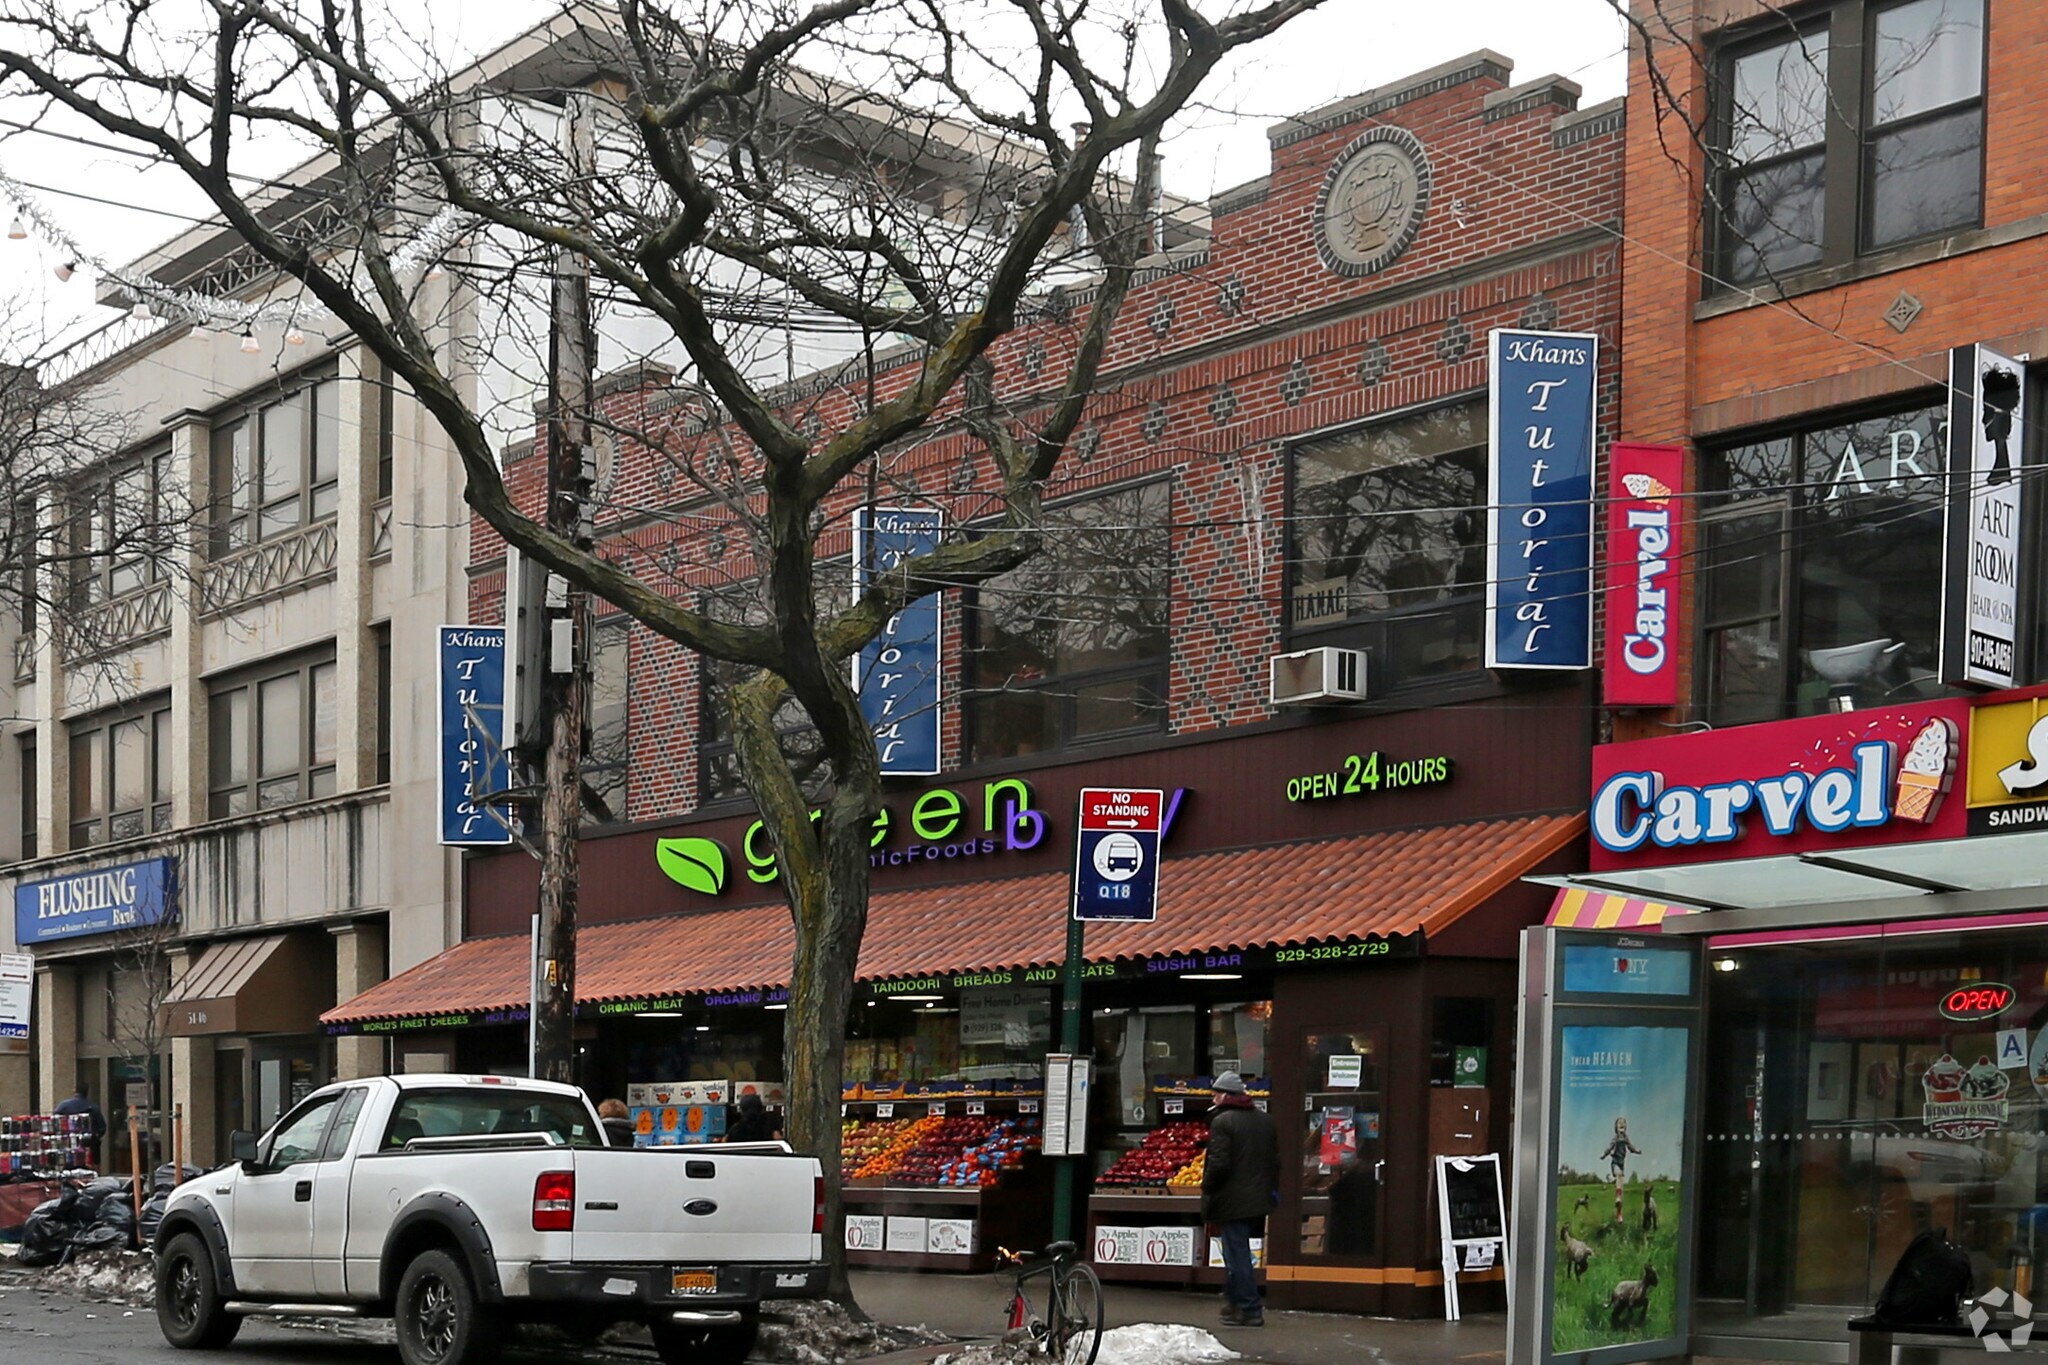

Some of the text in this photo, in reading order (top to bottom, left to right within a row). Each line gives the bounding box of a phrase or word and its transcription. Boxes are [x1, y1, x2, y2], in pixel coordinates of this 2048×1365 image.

[1505, 340, 1586, 367] Khan's
[1823, 421, 1948, 501] AR
[1514, 377, 1568, 654] Tutorial
[1979, 495, 2014, 539] ART
[1974, 540, 2015, 589] ROOM
[1622, 508, 1669, 675] Carvel
[1972, 593, 2013, 626] HAIR SPA
[446, 631, 504, 648] Khan's
[876, 547, 916, 764] Ttorial
[1286, 751, 1447, 801] OPEN 24 HOURS
[1112, 793, 1130, 804] NO
[1592, 740, 1892, 853] Carvel
[1093, 805, 1149, 816] STANDING
[38, 868, 137, 919] FLUSHING
[1099, 885, 1130, 898] Q18
[112, 906, 136, 926] Bank
[1147, 954, 1241, 972] SUSHI BAR
[1276, 942, 1389, 963] 929-328-2729
[1613, 957, 1648, 974] I NY
[872, 979, 940, 993] TANDOORI
[953, 973, 1013, 987] BREADS
[1025, 969, 1057, 982] AND
[600, 999, 684, 1014] ORGANIC MEAT
[705, 992, 760, 1007] ORGANIC
[1949, 990, 2008, 1011] OPEN
[363, 1020, 398, 1032] WORLD'S
[400, 1017, 427, 1029] FINEST
[431, 1015, 469, 1026] CHEESES
[2002, 1034, 2022, 1058] A
[1593, 1052, 1632, 1066] HEAVEN
[859, 1218, 880, 1227] Apples
[1111, 1230, 1138, 1239] Apples
[1160, 1230, 1189, 1240] Apples
